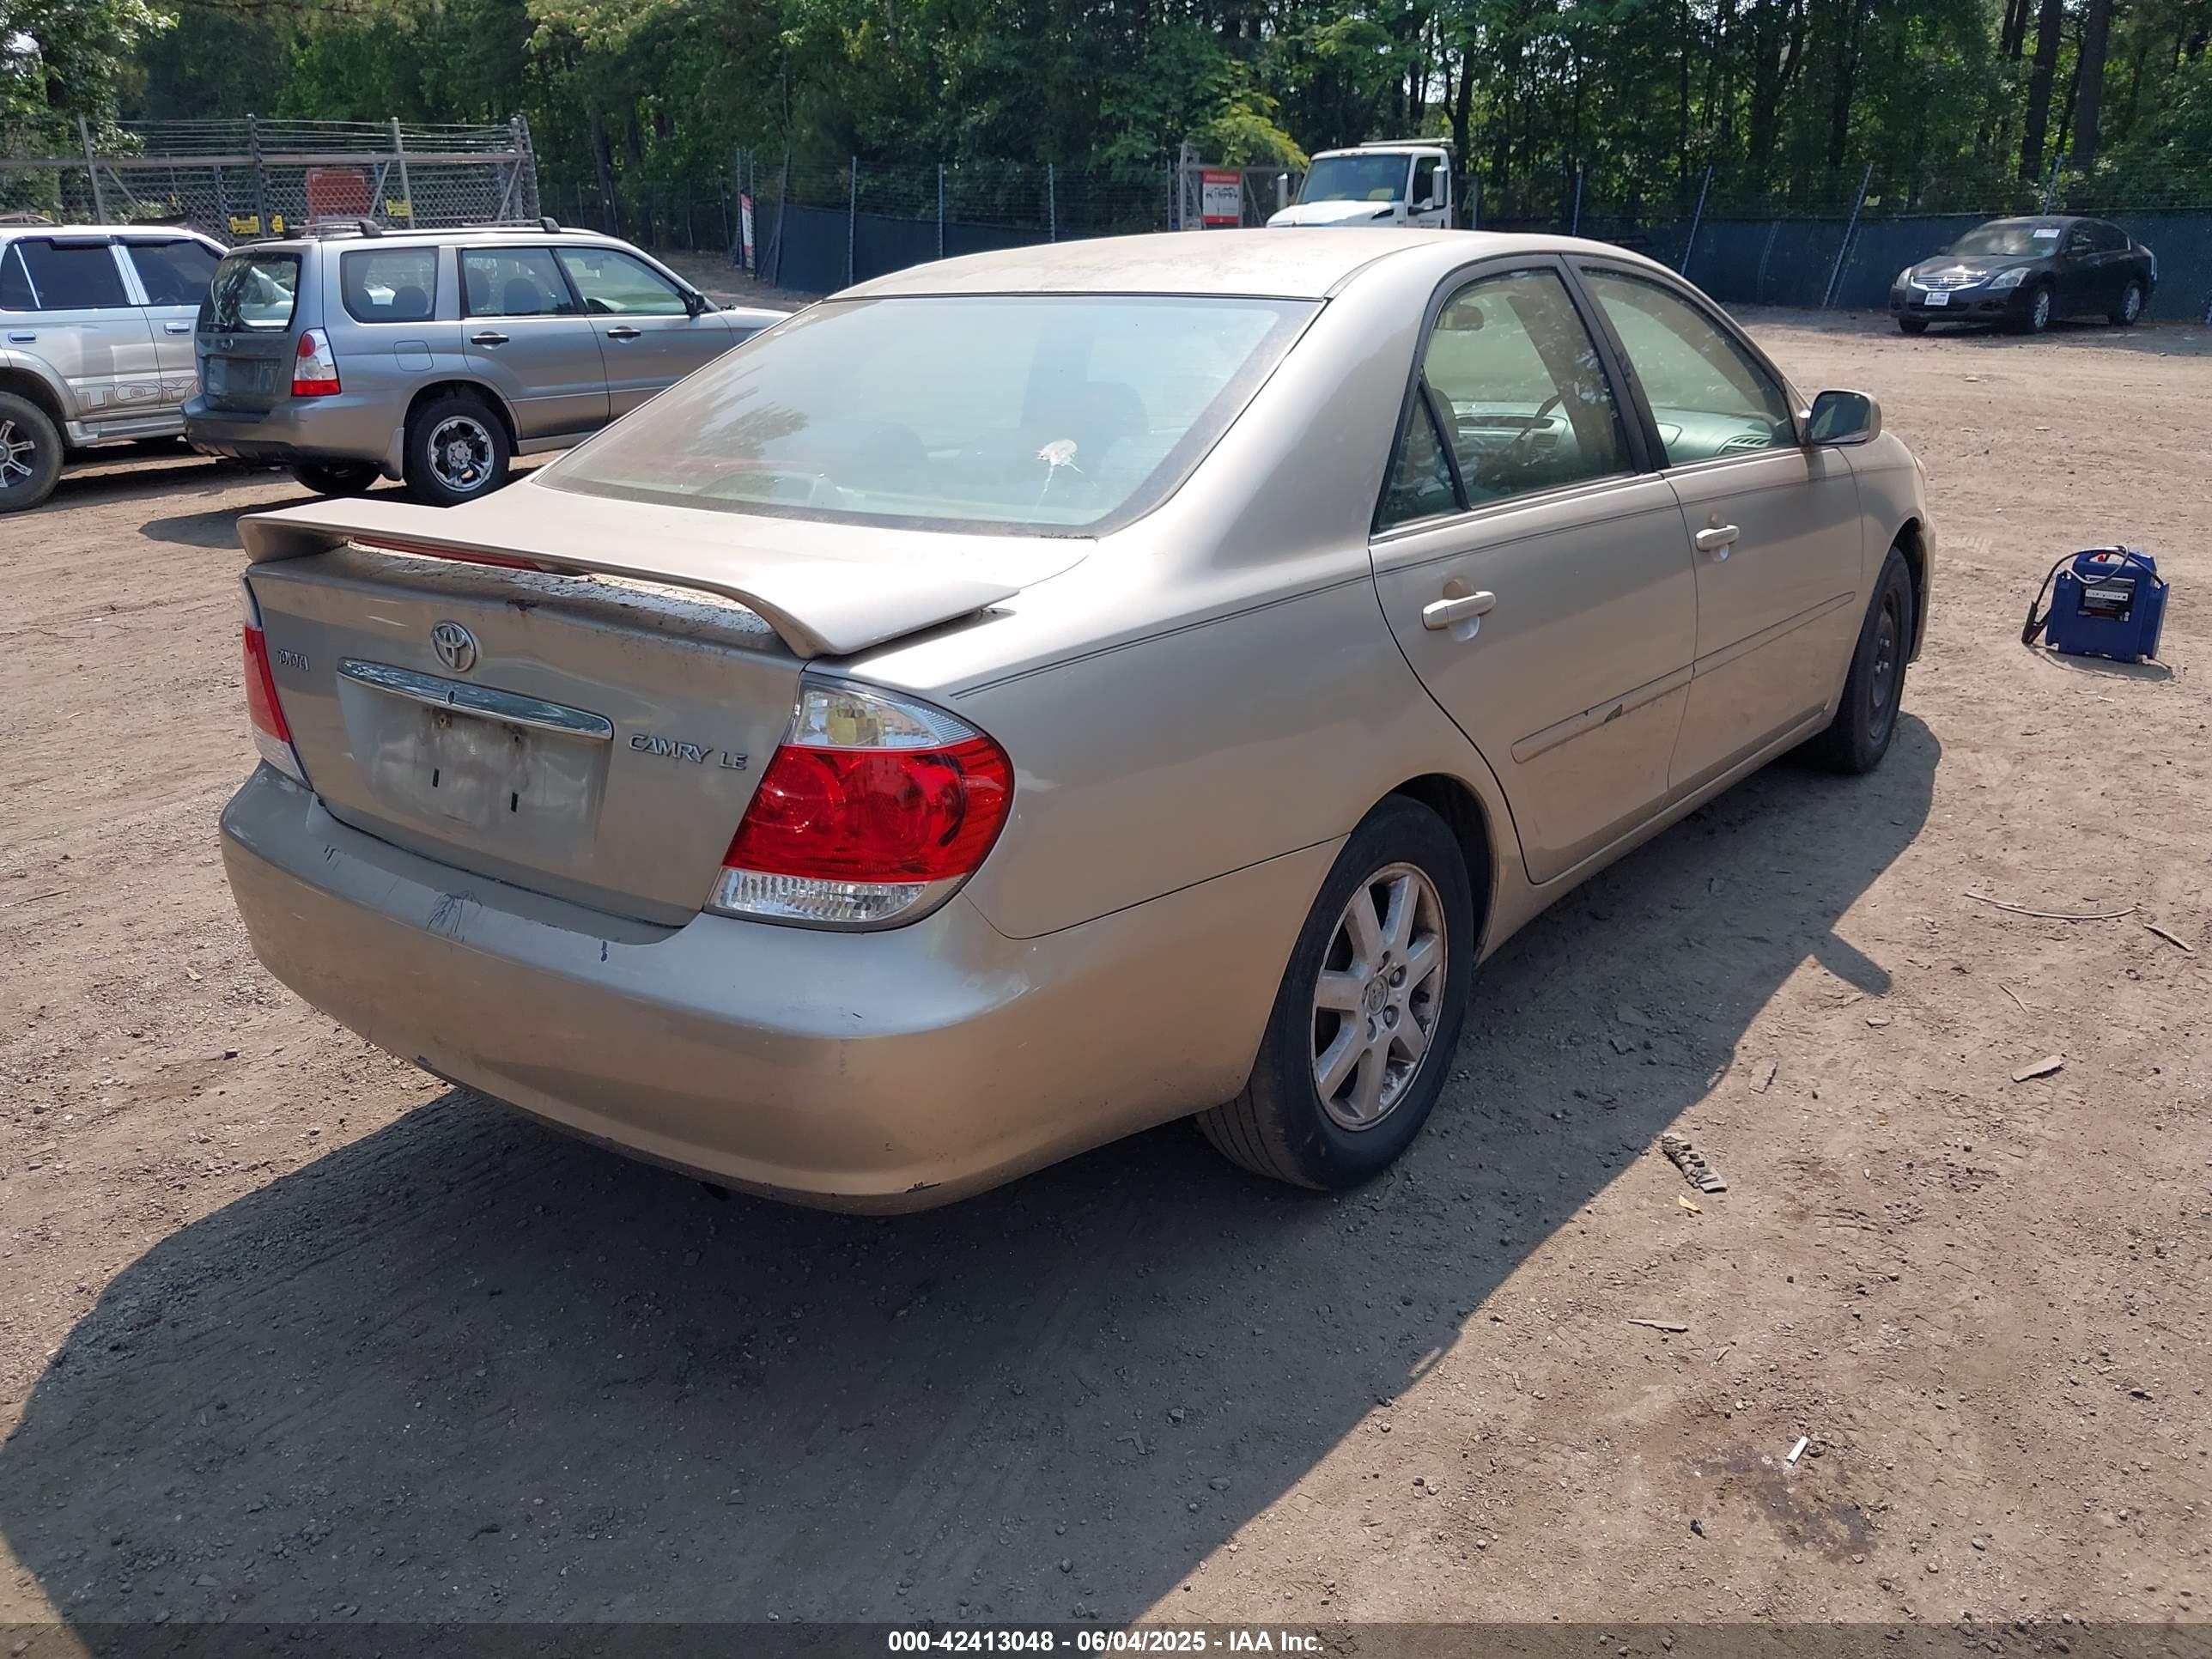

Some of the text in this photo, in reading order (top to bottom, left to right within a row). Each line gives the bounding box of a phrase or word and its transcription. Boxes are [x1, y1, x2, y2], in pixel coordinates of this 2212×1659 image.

[75, 378, 200, 408] TOY
[629, 733, 748, 770] CAMRY LE
